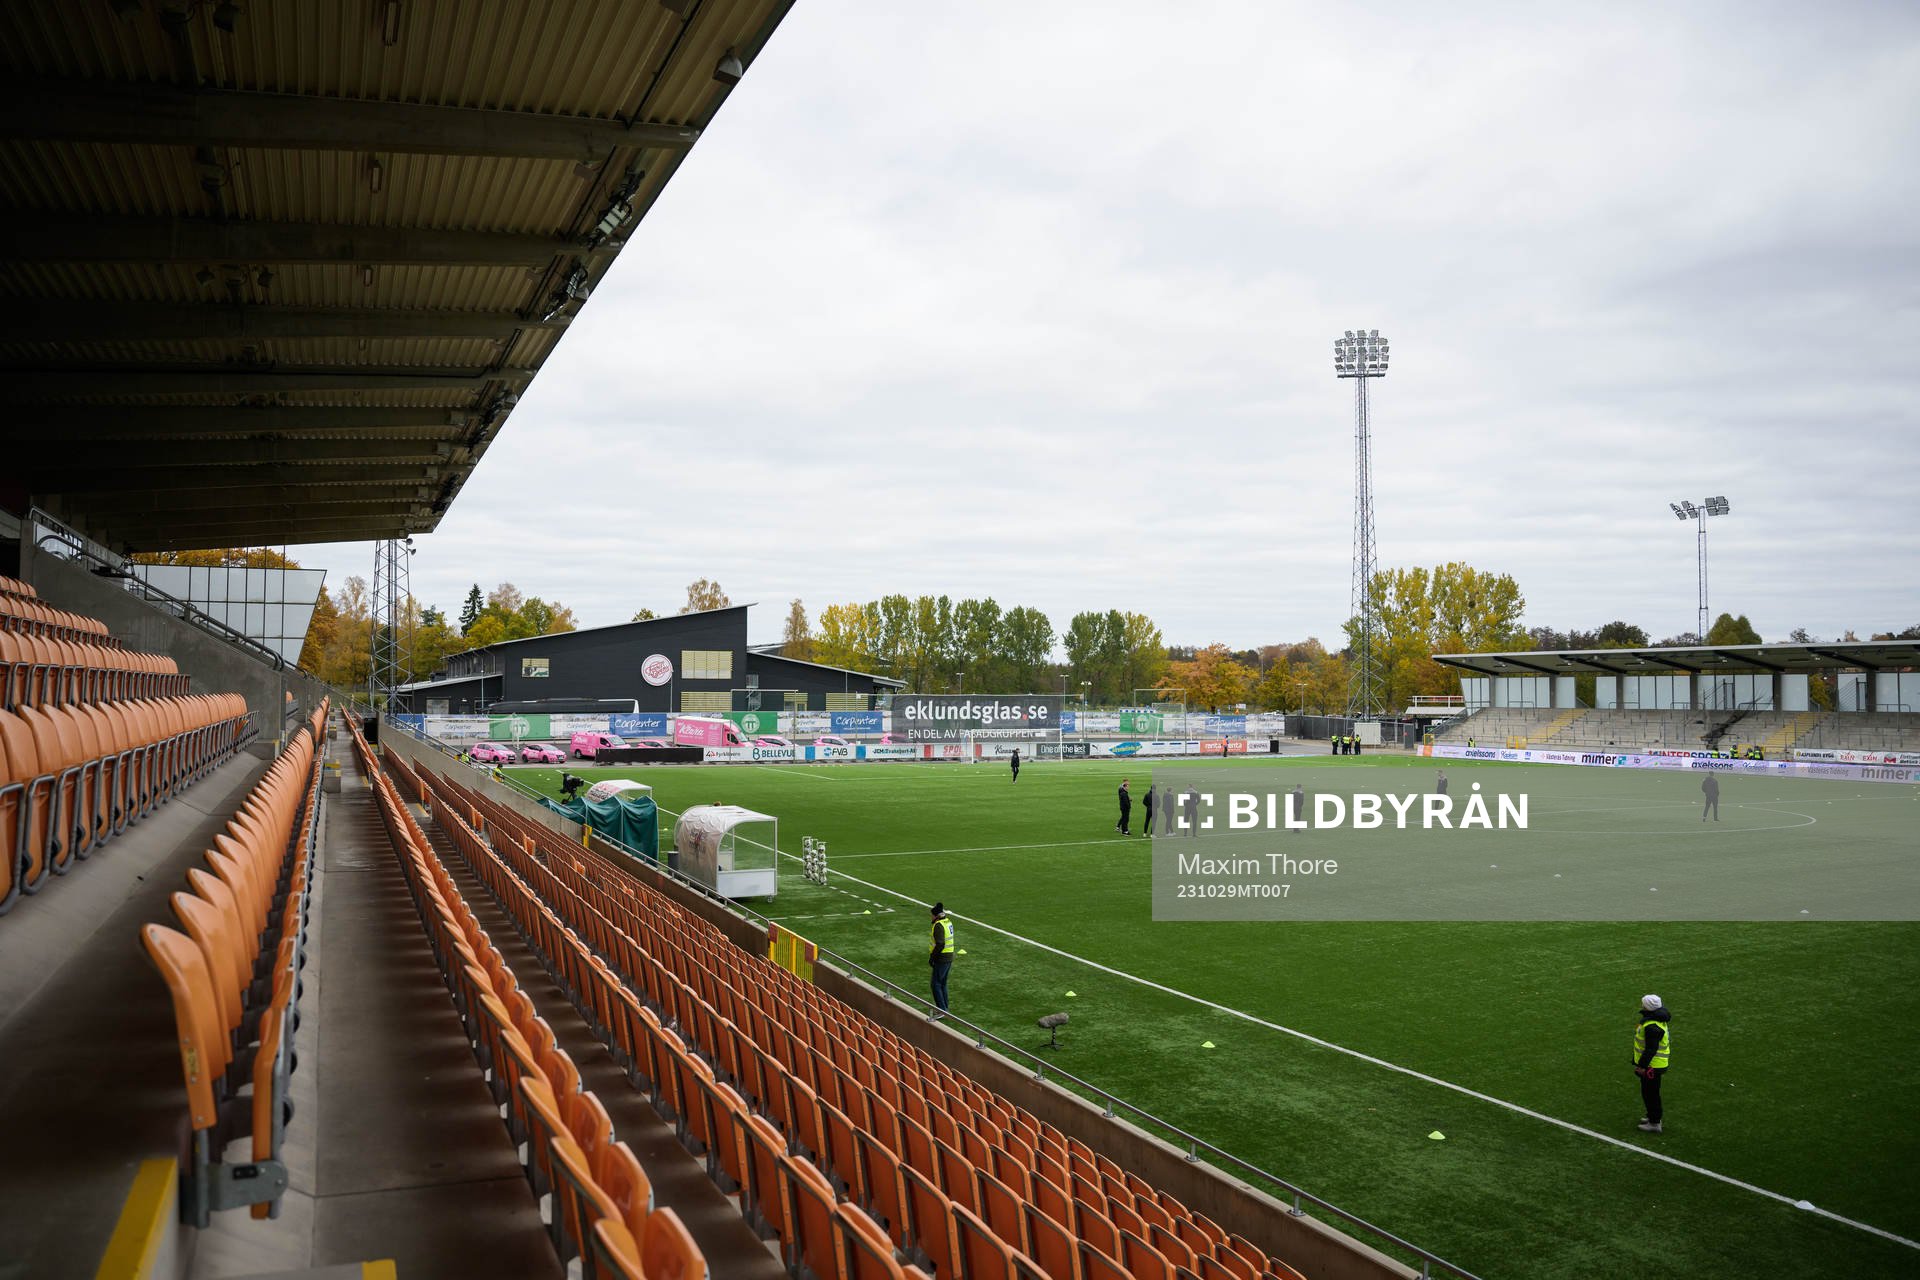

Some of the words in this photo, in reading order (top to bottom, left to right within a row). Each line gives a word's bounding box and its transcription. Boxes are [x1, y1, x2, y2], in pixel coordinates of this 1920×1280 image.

[905, 700, 1048, 724] eklundsglas.se
[614, 717, 661, 730] Carpenter
[835, 715, 878, 727] Carpenter
[908, 729, 921, 738] EN
[923, 729, 942, 738] DEL
[944, 729, 957, 738] AV
[1581, 753, 1617, 765] mimer
[1691, 761, 1734, 771] axelssons
[1861, 767, 1912, 780] mimer
